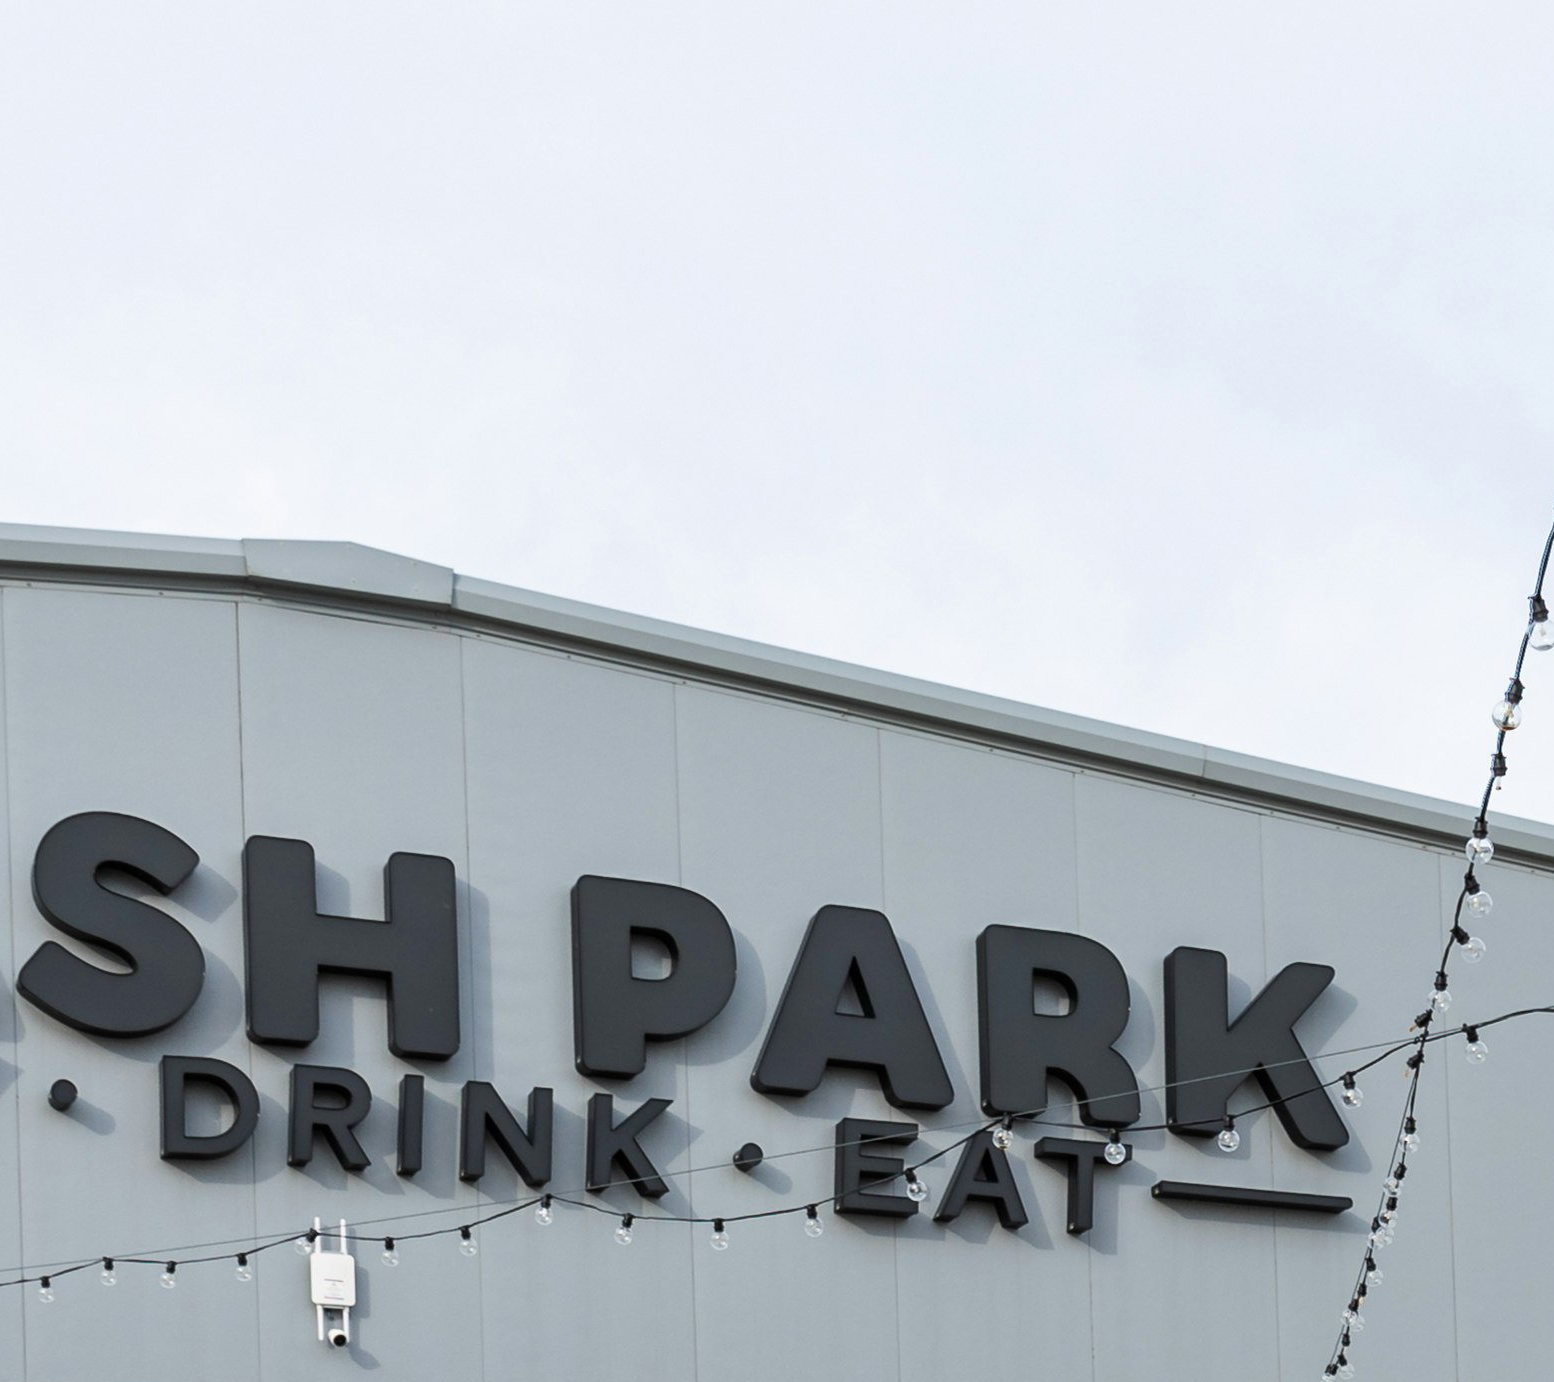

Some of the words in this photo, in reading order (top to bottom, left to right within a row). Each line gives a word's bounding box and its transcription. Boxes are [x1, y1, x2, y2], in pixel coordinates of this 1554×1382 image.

[570, 873, 1350, 1151] PARK
[158, 1054, 674, 1199] DRINK
[833, 1117, 1133, 1235] EAT
